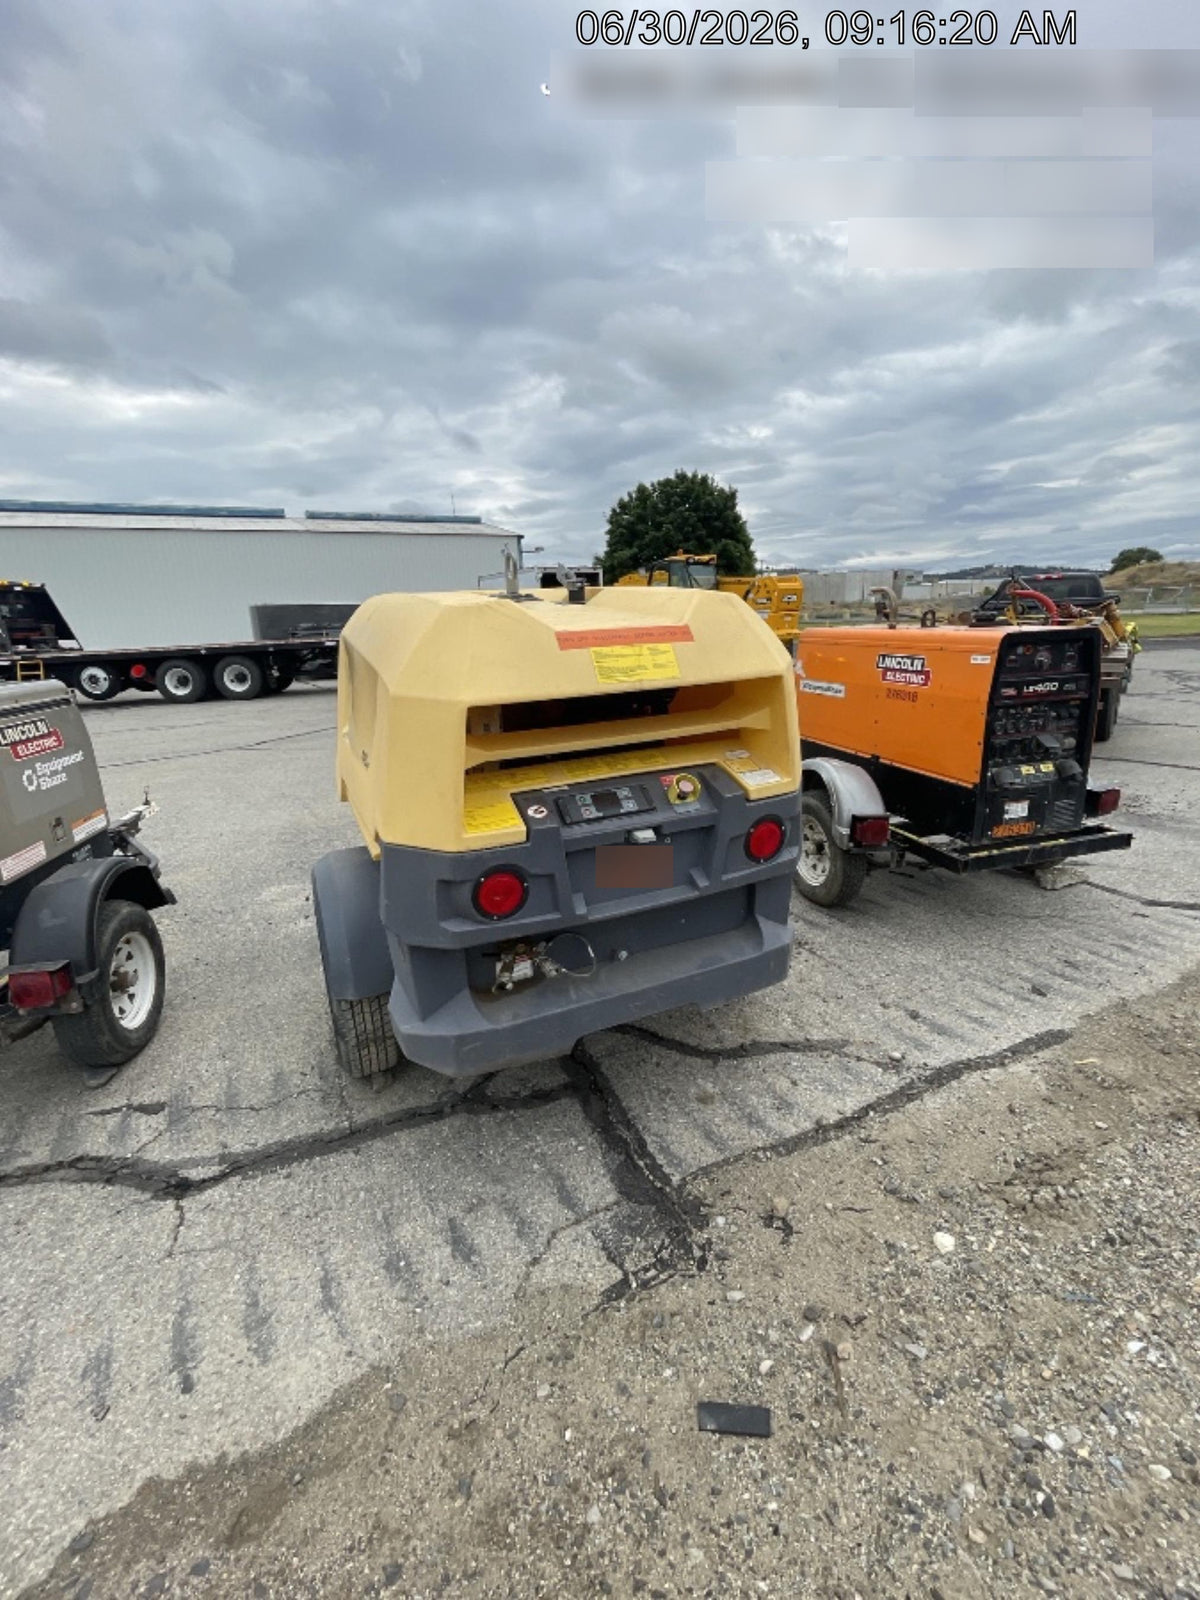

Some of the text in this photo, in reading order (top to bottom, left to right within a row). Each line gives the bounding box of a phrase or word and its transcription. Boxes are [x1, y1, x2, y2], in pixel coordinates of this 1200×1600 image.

[878, 655, 924, 671] LINCOLN
[0, 721, 49, 745] LINCOLN
[17, 736, 59, 756] ELECTRIC
[35, 750, 84, 775] Equipment
[38, 773, 67, 790] Share
